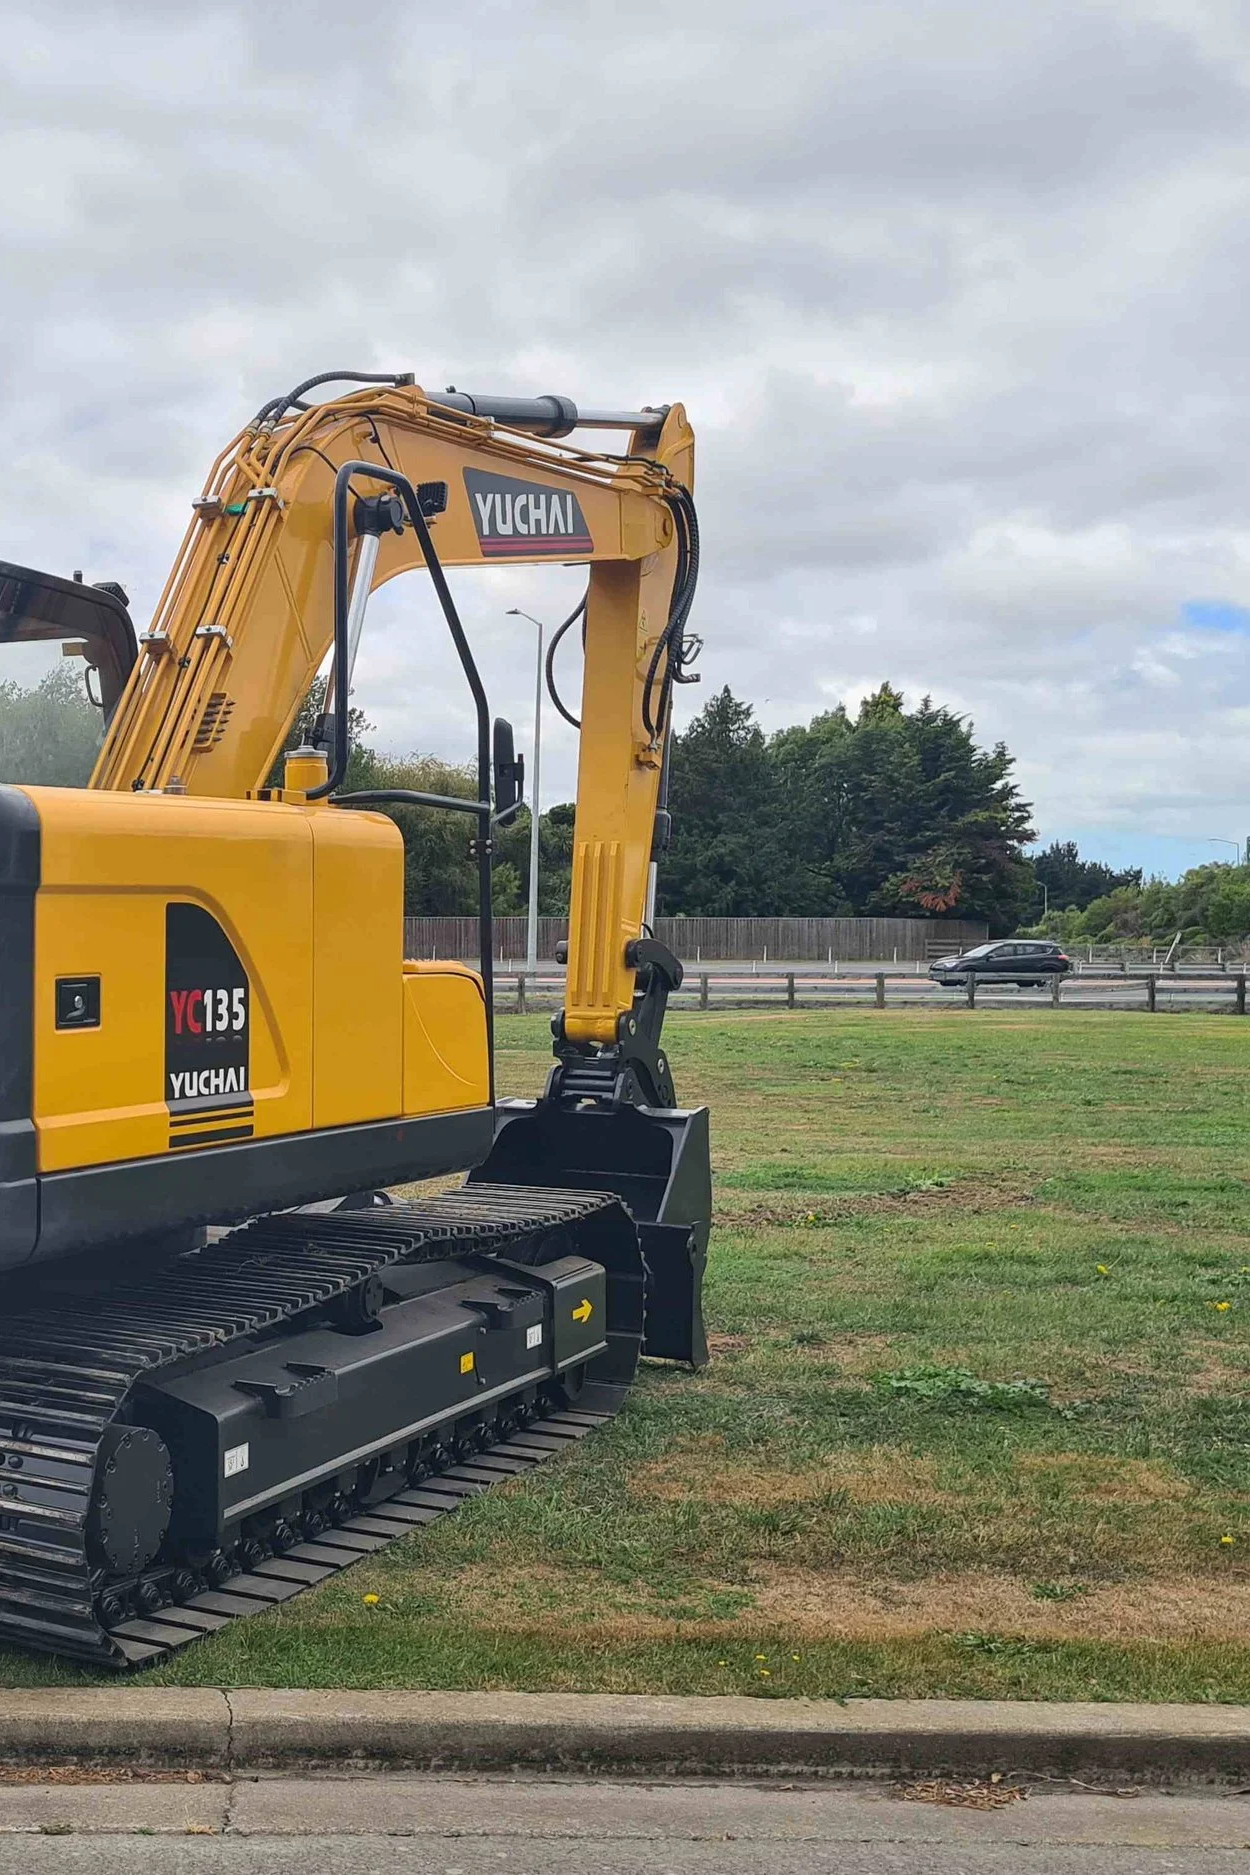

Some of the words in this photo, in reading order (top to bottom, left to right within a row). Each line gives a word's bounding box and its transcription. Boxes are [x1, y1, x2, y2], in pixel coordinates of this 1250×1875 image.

[474, 493, 573, 535] YUCHAI
[170, 987, 245, 1034] YC135
[170, 1066, 245, 1099] YUCHAI
